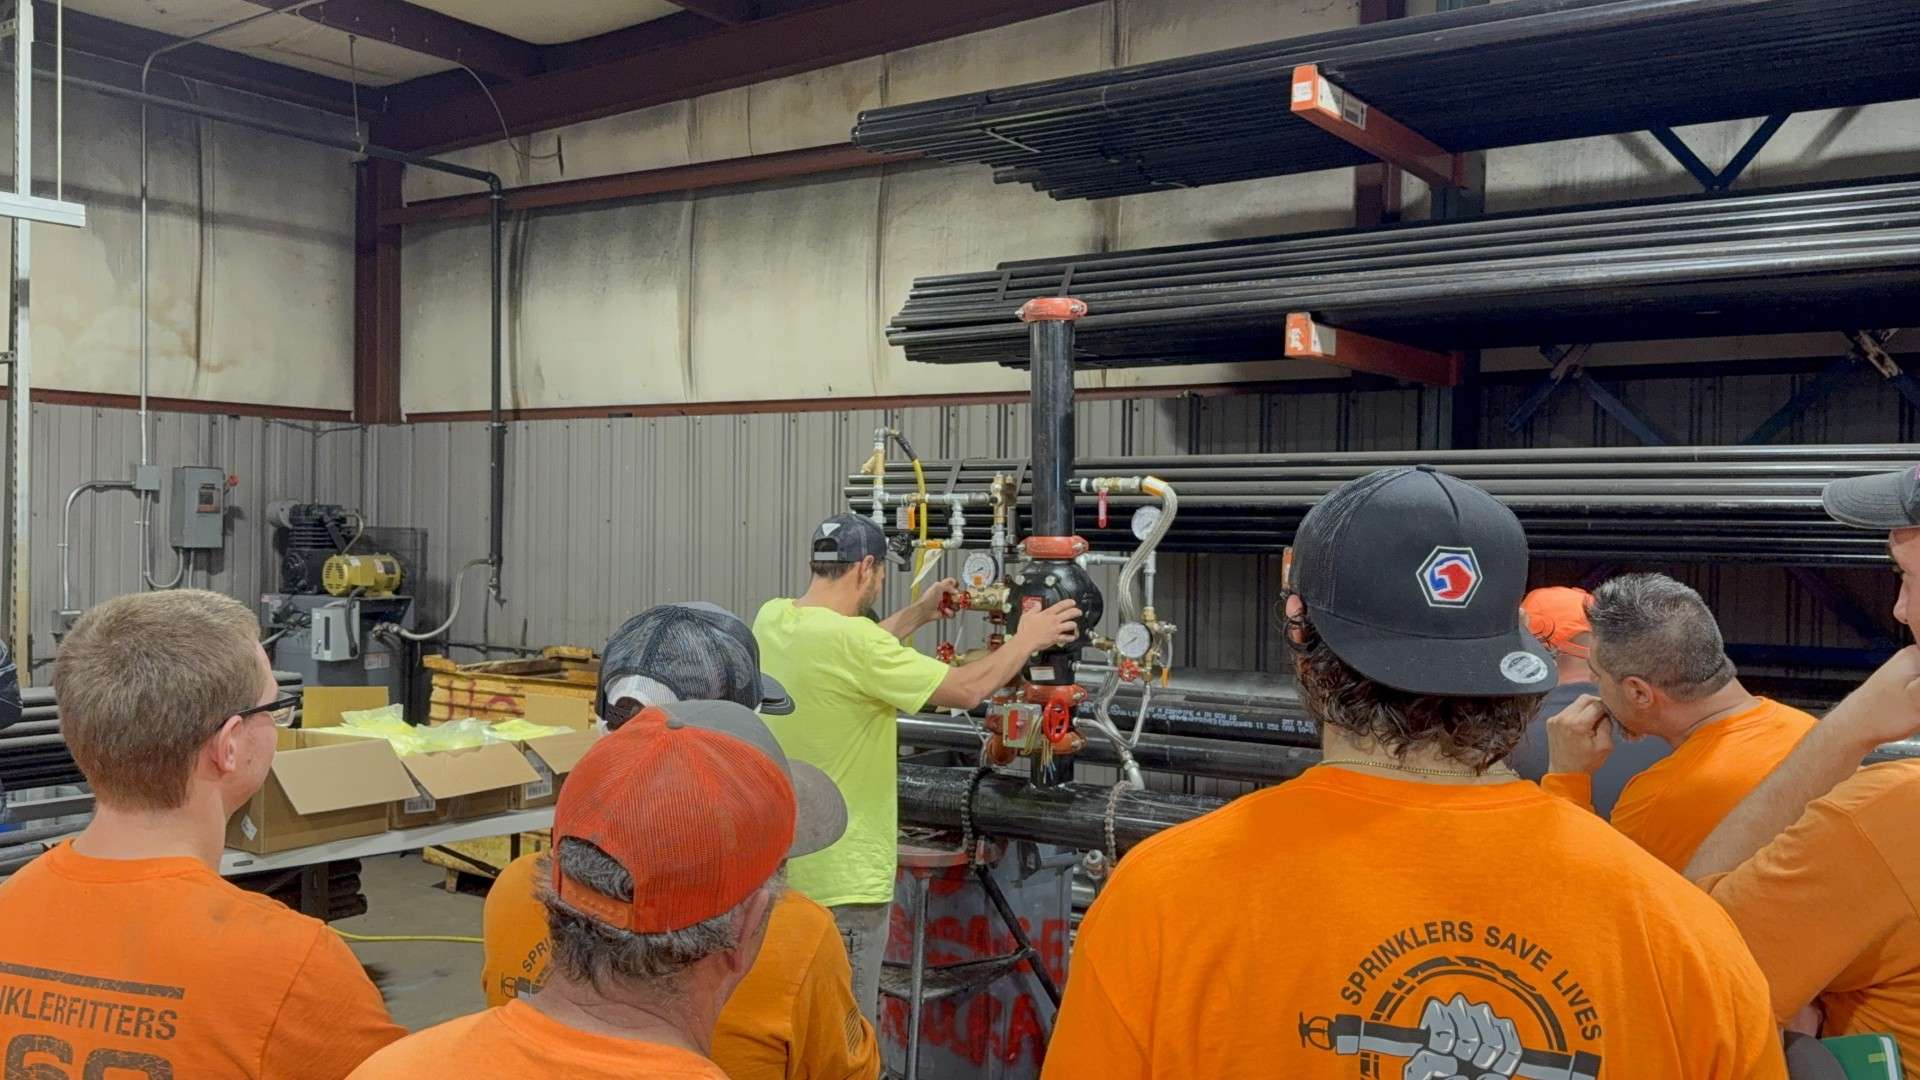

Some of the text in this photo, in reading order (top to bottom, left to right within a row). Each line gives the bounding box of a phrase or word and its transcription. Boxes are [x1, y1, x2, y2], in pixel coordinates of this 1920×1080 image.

[1341, 920, 1601, 1041] SPRINKLERS SAVE LIVES
